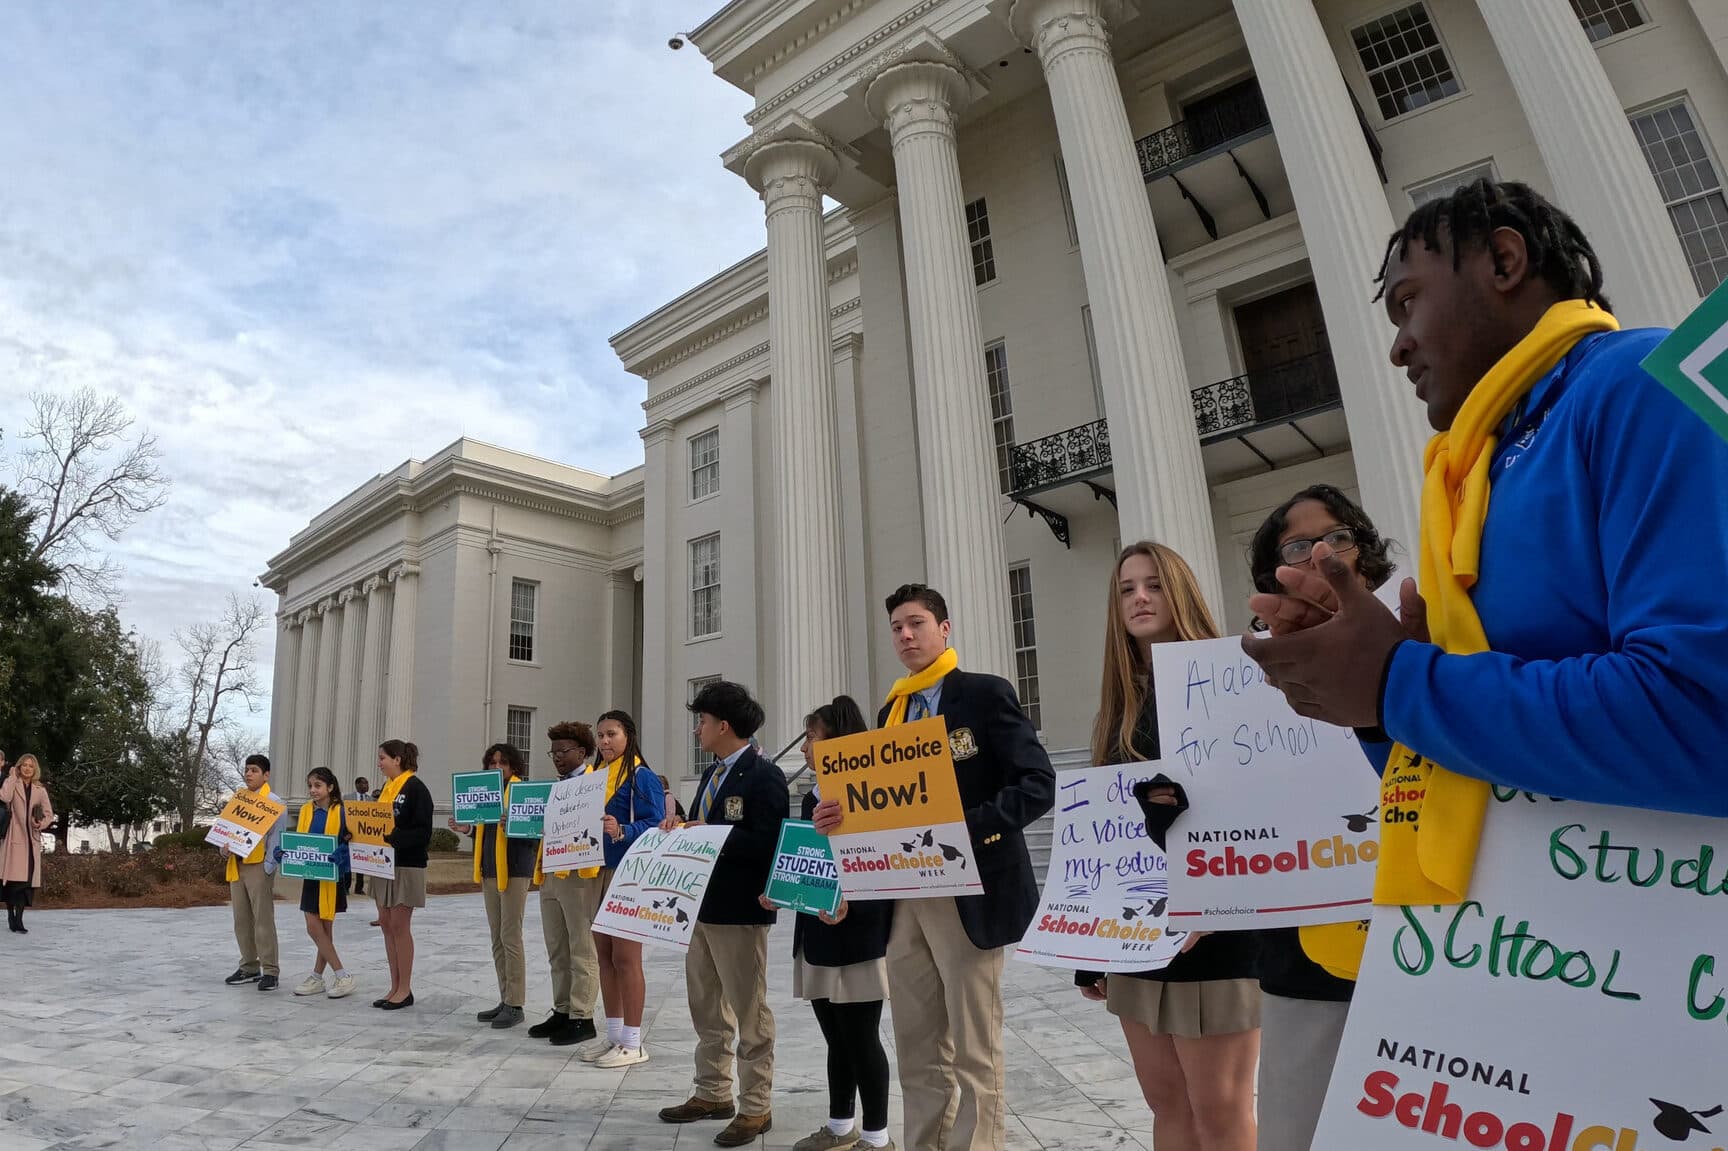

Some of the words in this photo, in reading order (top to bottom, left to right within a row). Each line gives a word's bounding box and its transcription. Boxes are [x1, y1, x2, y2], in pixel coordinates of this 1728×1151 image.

[822, 745, 875, 775] School
[880, 736, 943, 764] Choice
[1176, 726, 1218, 776] for
[1233, 718, 1318, 766] School
[456, 792, 500, 803] STUDENTS
[846, 771, 928, 813] Now!
[1060, 778, 1090, 812] I
[234, 792, 258, 806] School
[256, 801, 279, 816] Choice
[347, 807, 370, 817] School
[371, 808, 392, 819] Choice
[511, 805, 546, 814] STUDEN
[231, 804, 265, 825] Now!
[1384, 805, 1422, 823] Cho
[357, 820, 386, 836] Now!
[1061, 822, 1084, 845] a
[1092, 815, 1149, 844] voice
[1187, 827, 1279, 843] NATIONAL
[636, 832, 671, 850] MY
[797, 846, 825, 858] STRONG
[840, 846, 876, 855] NATIONAL
[1186, 834, 1379, 878] SchoolCho
[776, 855, 838, 878] STUDENTS
[918, 869, 946, 878] WEEK
[1064, 857, 1110, 891] my
[1115, 851, 1167, 877] educ
[620, 856, 654, 886] MY
[648, 861, 708, 897] CHOICE
[773, 871, 801, 884] STRONG
[801, 876, 837, 890] ALABAMA
[611, 893, 636, 903] NATIONAL
[1047, 903, 1090, 914] NATIONAL
[1203, 905, 1255, 916] #schoolchoice
[1121, 942, 1154, 952] WEEK
[1377, 1038, 1531, 1095] NATIONAL
